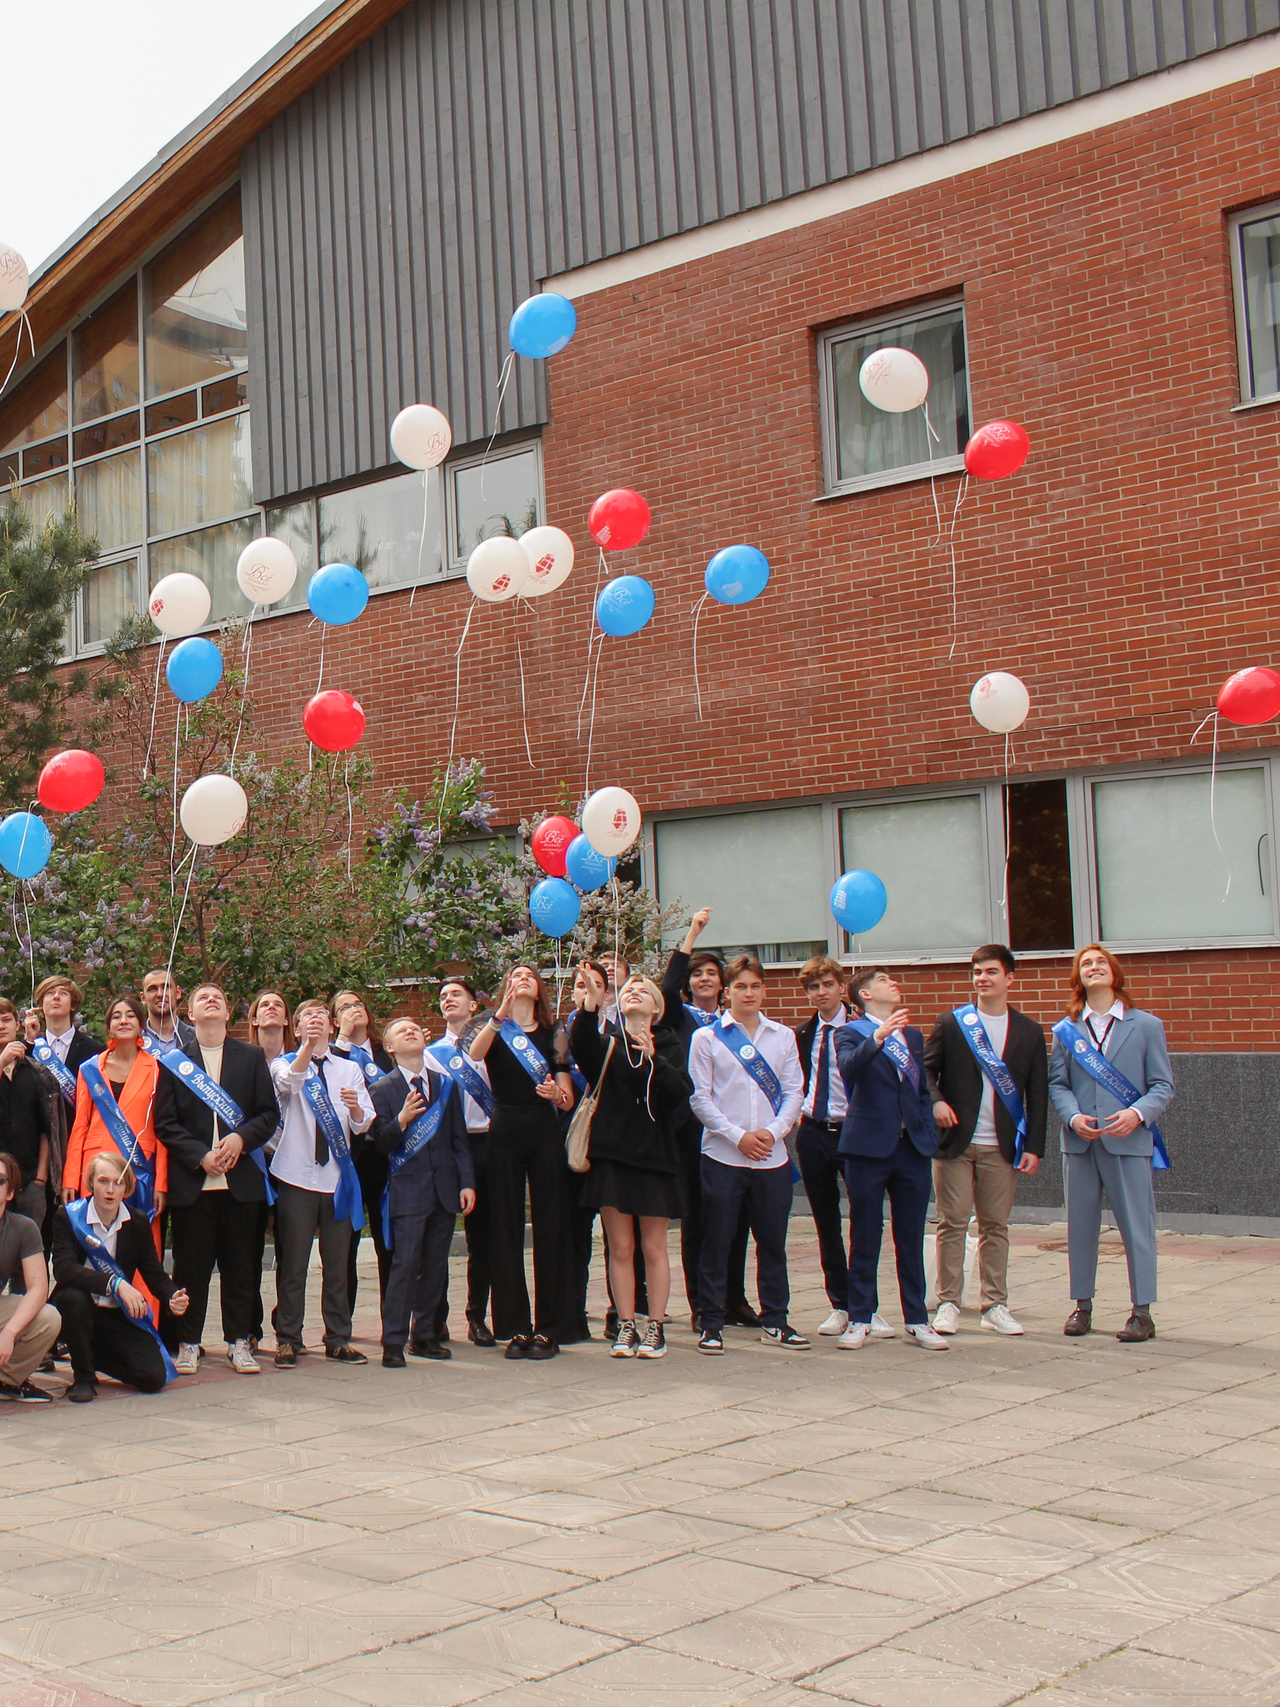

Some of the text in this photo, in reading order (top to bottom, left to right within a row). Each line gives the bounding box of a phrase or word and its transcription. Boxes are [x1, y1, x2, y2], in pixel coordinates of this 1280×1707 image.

[245, 564, 275, 583] Всё
[540, 830, 566, 844] Всё
[532, 896, 555, 910] Всё
[996, 1074, 1016, 1096] 2023
[1084, 1052, 1131, 1097] Выпускник
[1126, 1091, 1137, 1103] 2
[190, 1073, 237, 1119] Выпускник
[307, 1082, 338, 1137] Выпускник
